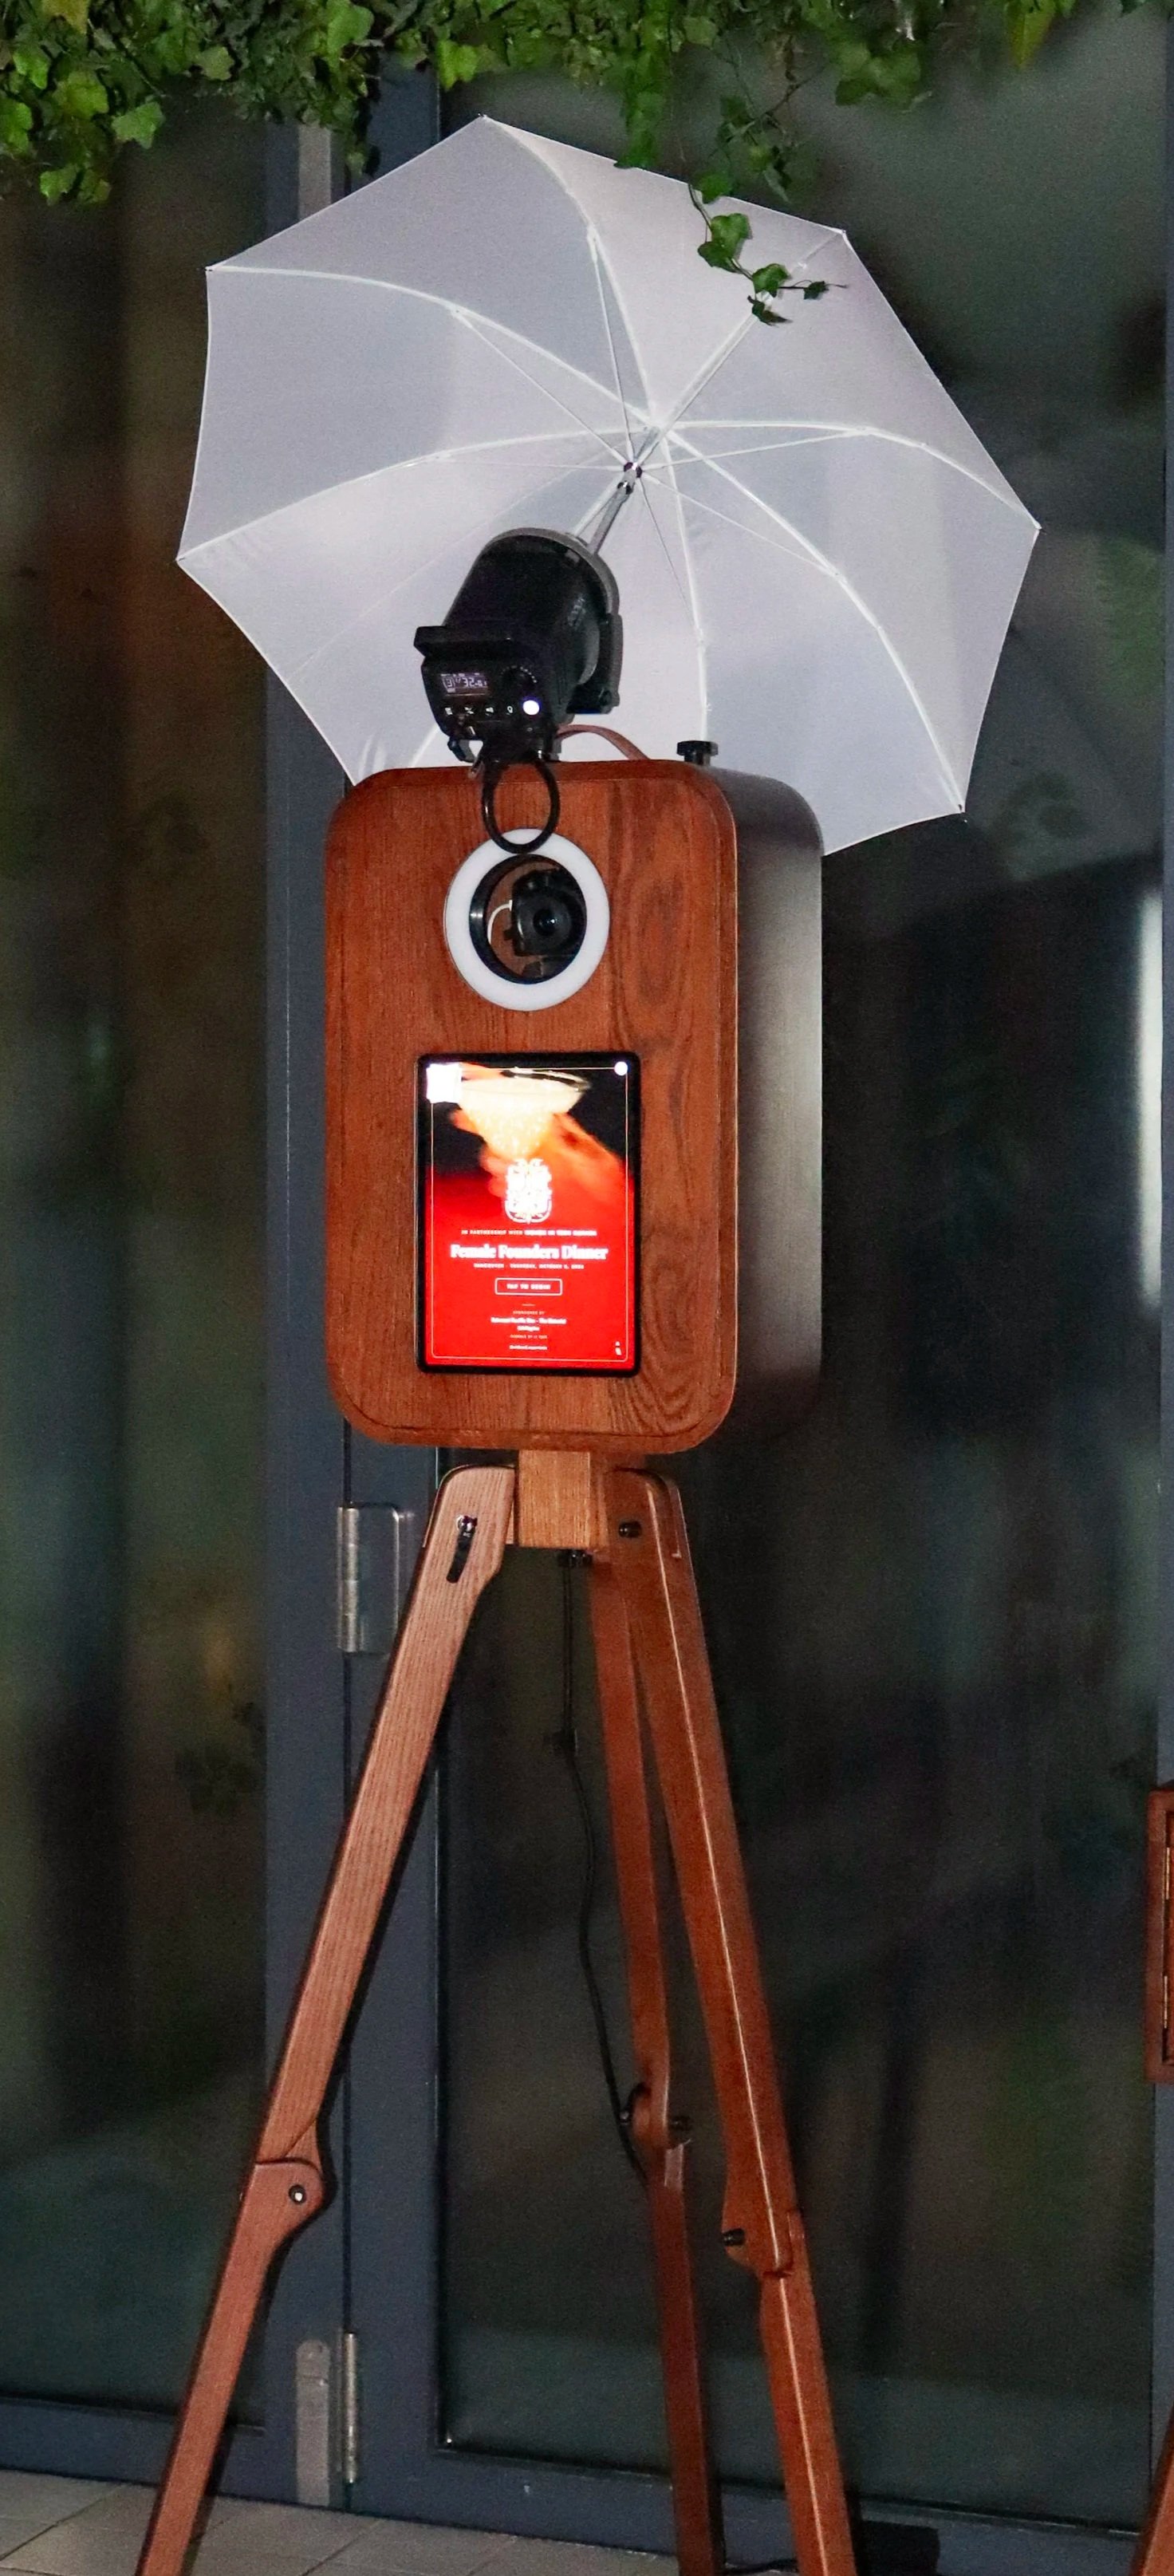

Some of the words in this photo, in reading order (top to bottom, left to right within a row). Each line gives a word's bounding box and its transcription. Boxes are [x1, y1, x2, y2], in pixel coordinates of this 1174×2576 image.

[451, 1244, 496, 1258] Female
[498, 1245, 559, 1259] Founders
[561, 1245, 609, 1259] Dinner
